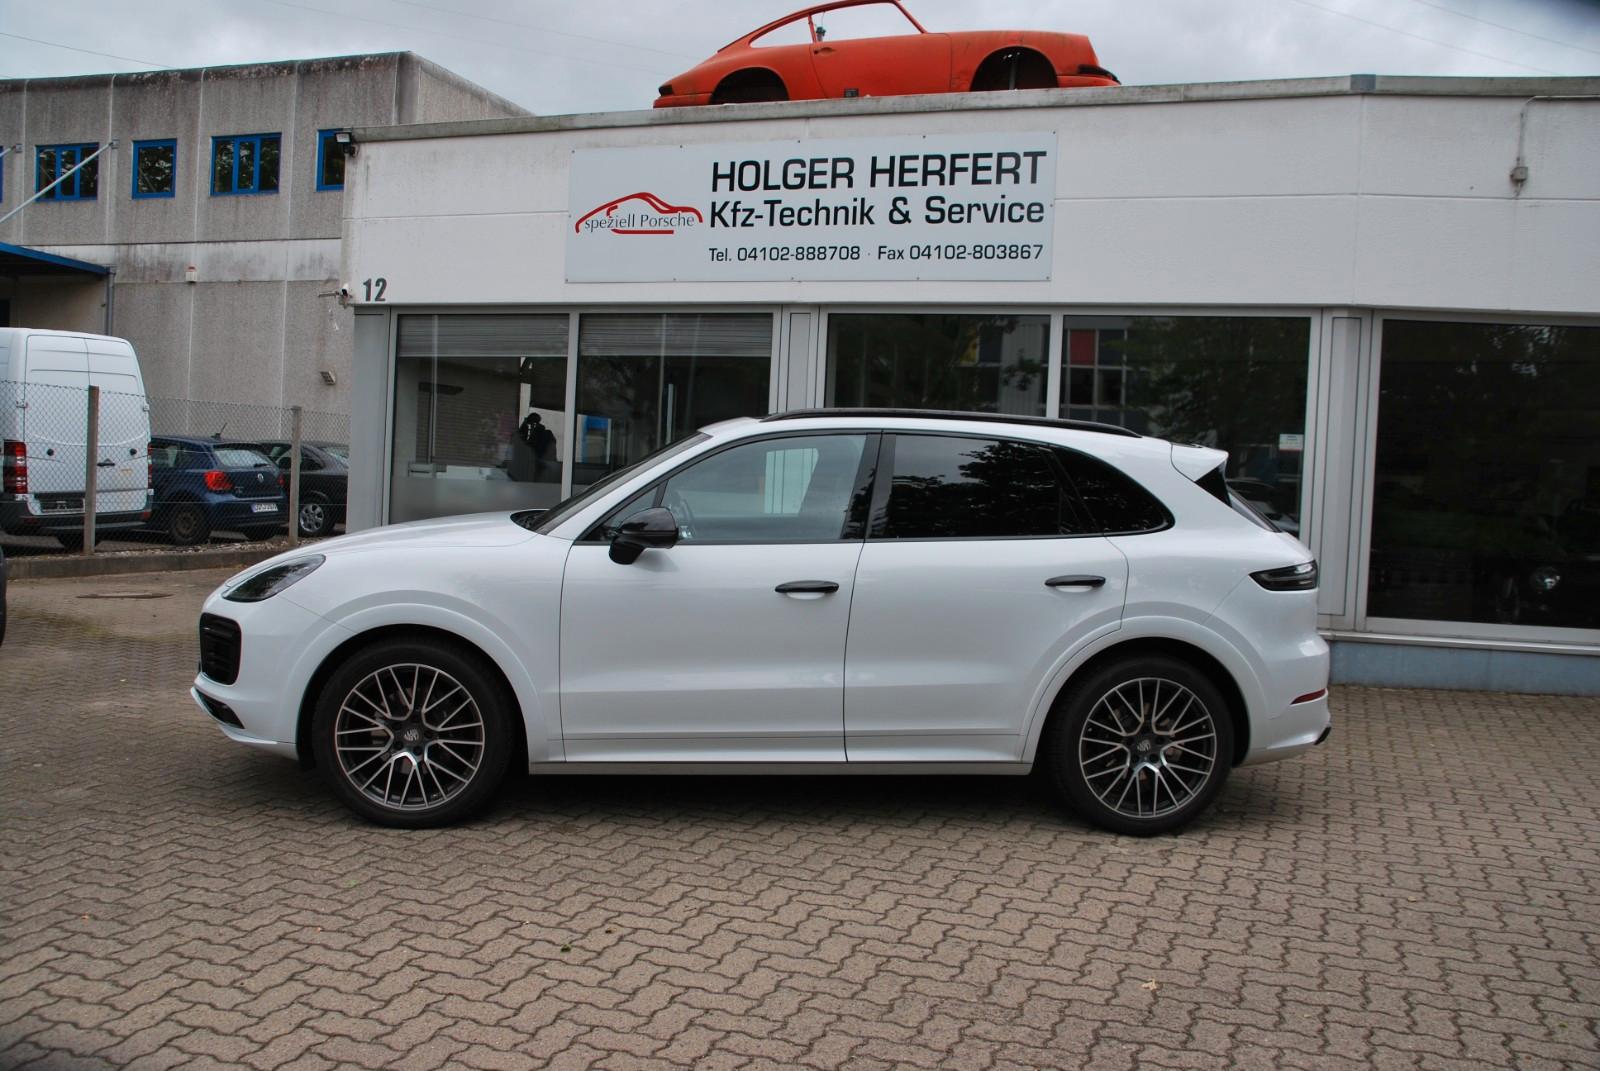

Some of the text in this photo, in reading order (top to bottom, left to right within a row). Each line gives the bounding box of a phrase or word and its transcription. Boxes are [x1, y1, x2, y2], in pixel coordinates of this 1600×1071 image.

[711, 151, 1047, 192] HOLGER HERFERT
[584, 212, 695, 232] speziell Porsche
[709, 194, 1045, 228] Kfz-Technik & Service
[708, 243, 1044, 262] Tel. 04102-888708 Fax 04102-803867
[363, 278, 387, 301] 12
